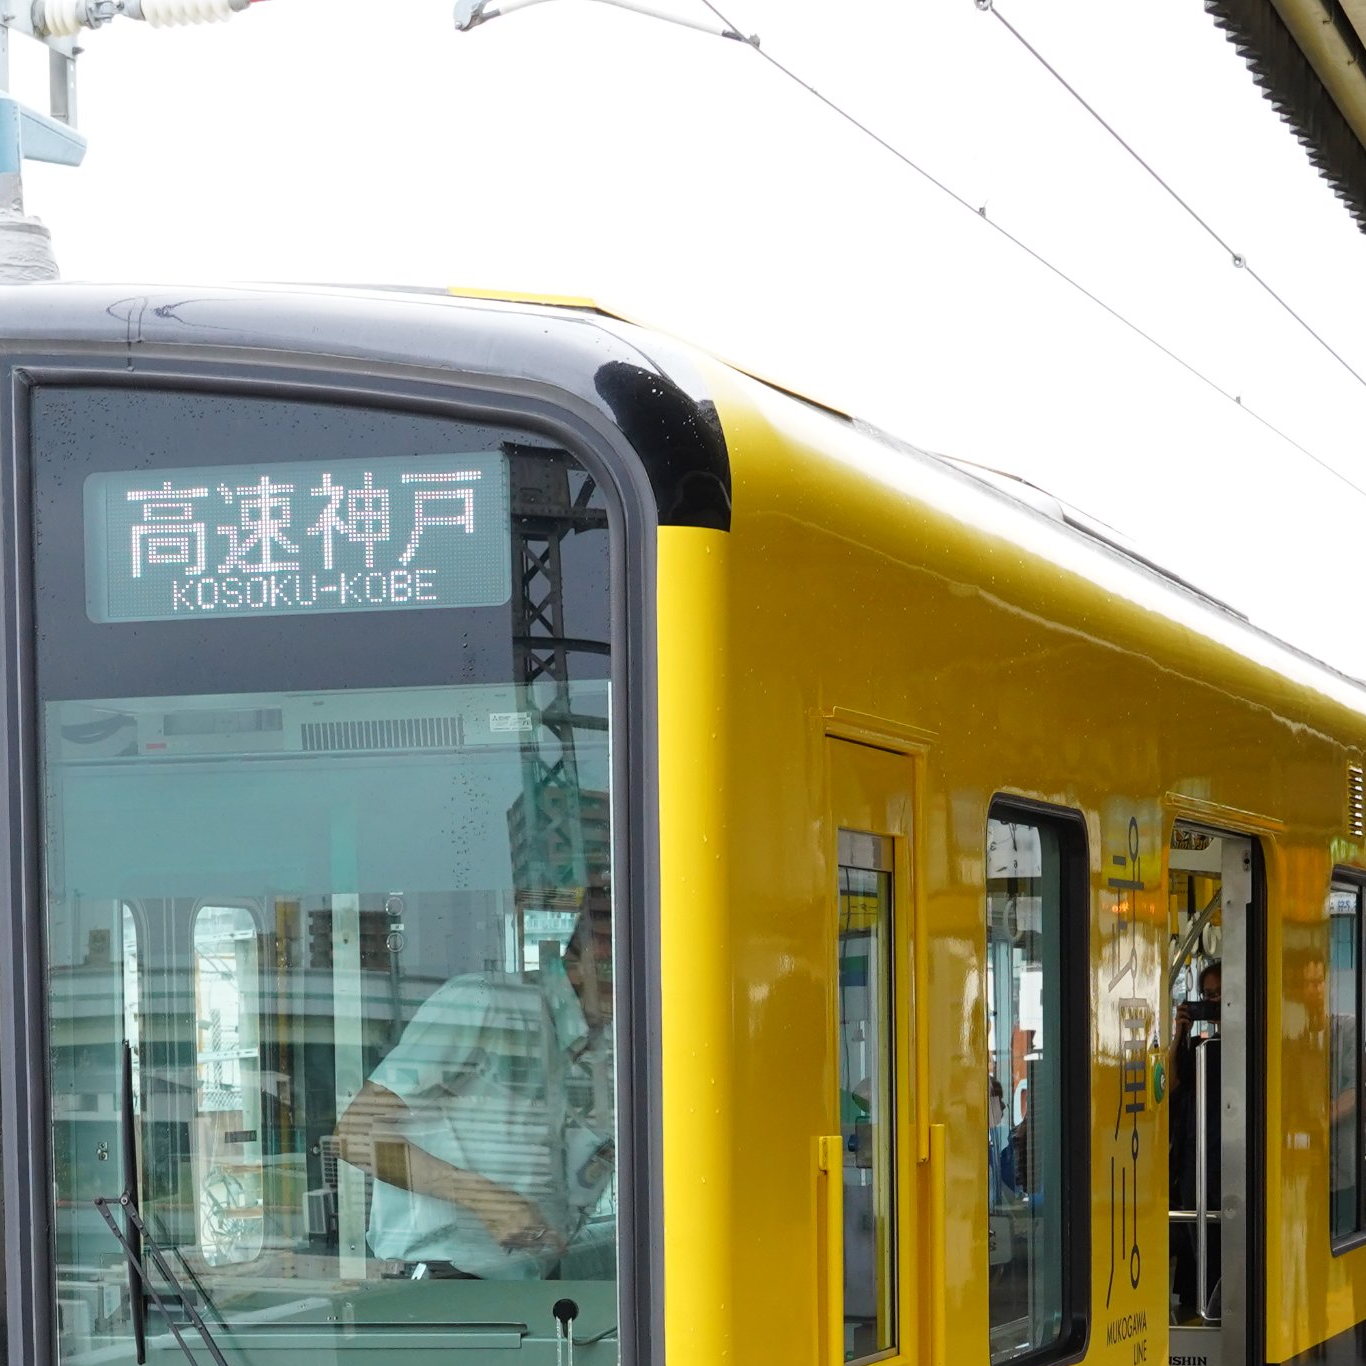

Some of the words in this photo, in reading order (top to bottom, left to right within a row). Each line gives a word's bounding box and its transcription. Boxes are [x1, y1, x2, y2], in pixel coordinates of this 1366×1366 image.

[126, 470, 482, 578] 高速神戸
[171, 569, 438, 611] KOSOKU-KOBE
[1106, 1309, 1148, 1347] MUKOGAWA
[1133, 1339, 1147, 1366] LINE
